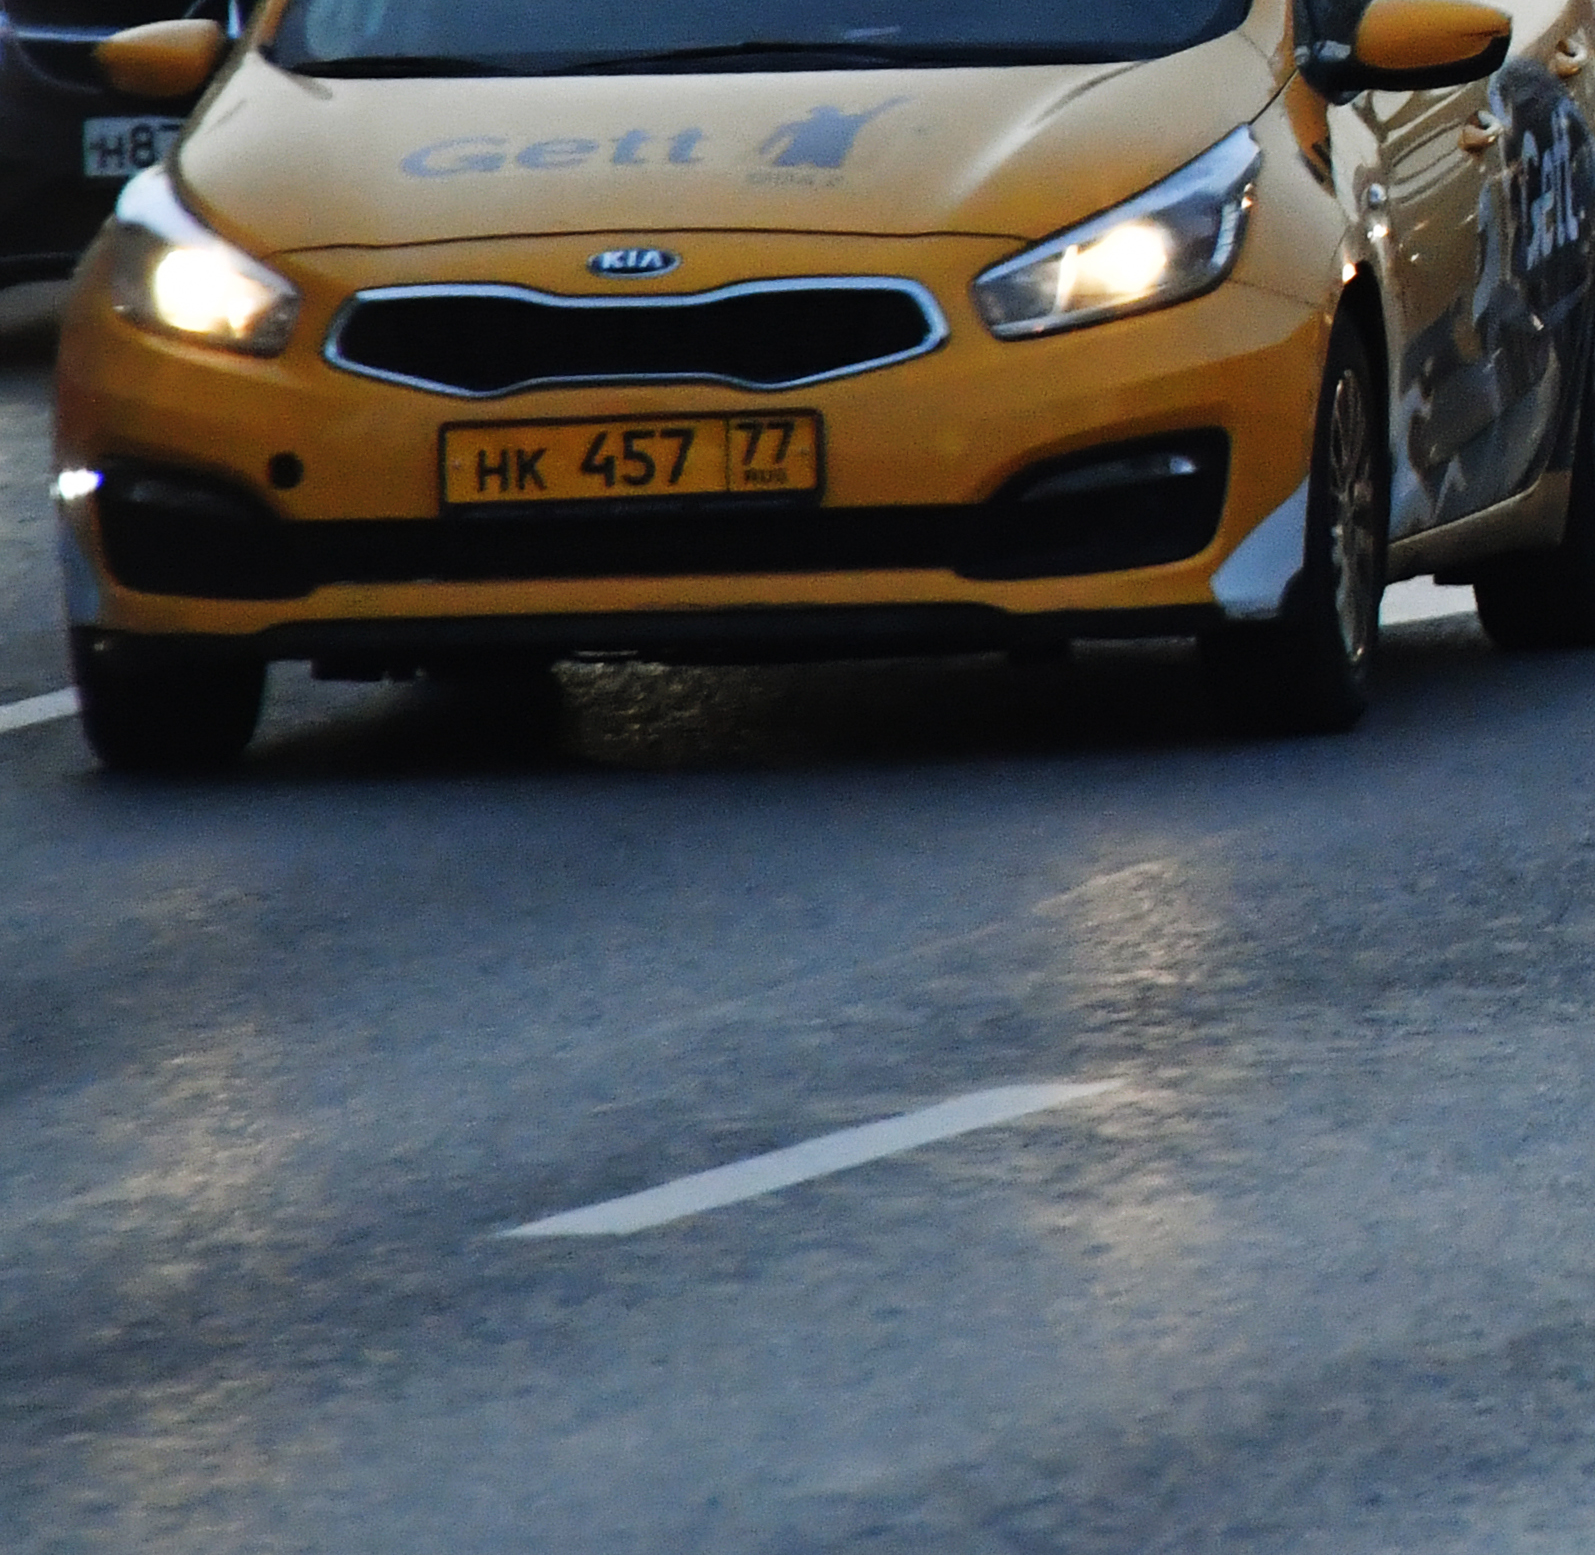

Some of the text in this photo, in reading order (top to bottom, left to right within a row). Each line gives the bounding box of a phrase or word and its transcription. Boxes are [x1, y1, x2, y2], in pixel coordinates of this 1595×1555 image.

[400, 128, 706, 178] Gett
[601, 249, 664, 270] KIA
[580, 428, 695, 488] 457
[737, 420, 796, 466] 77
